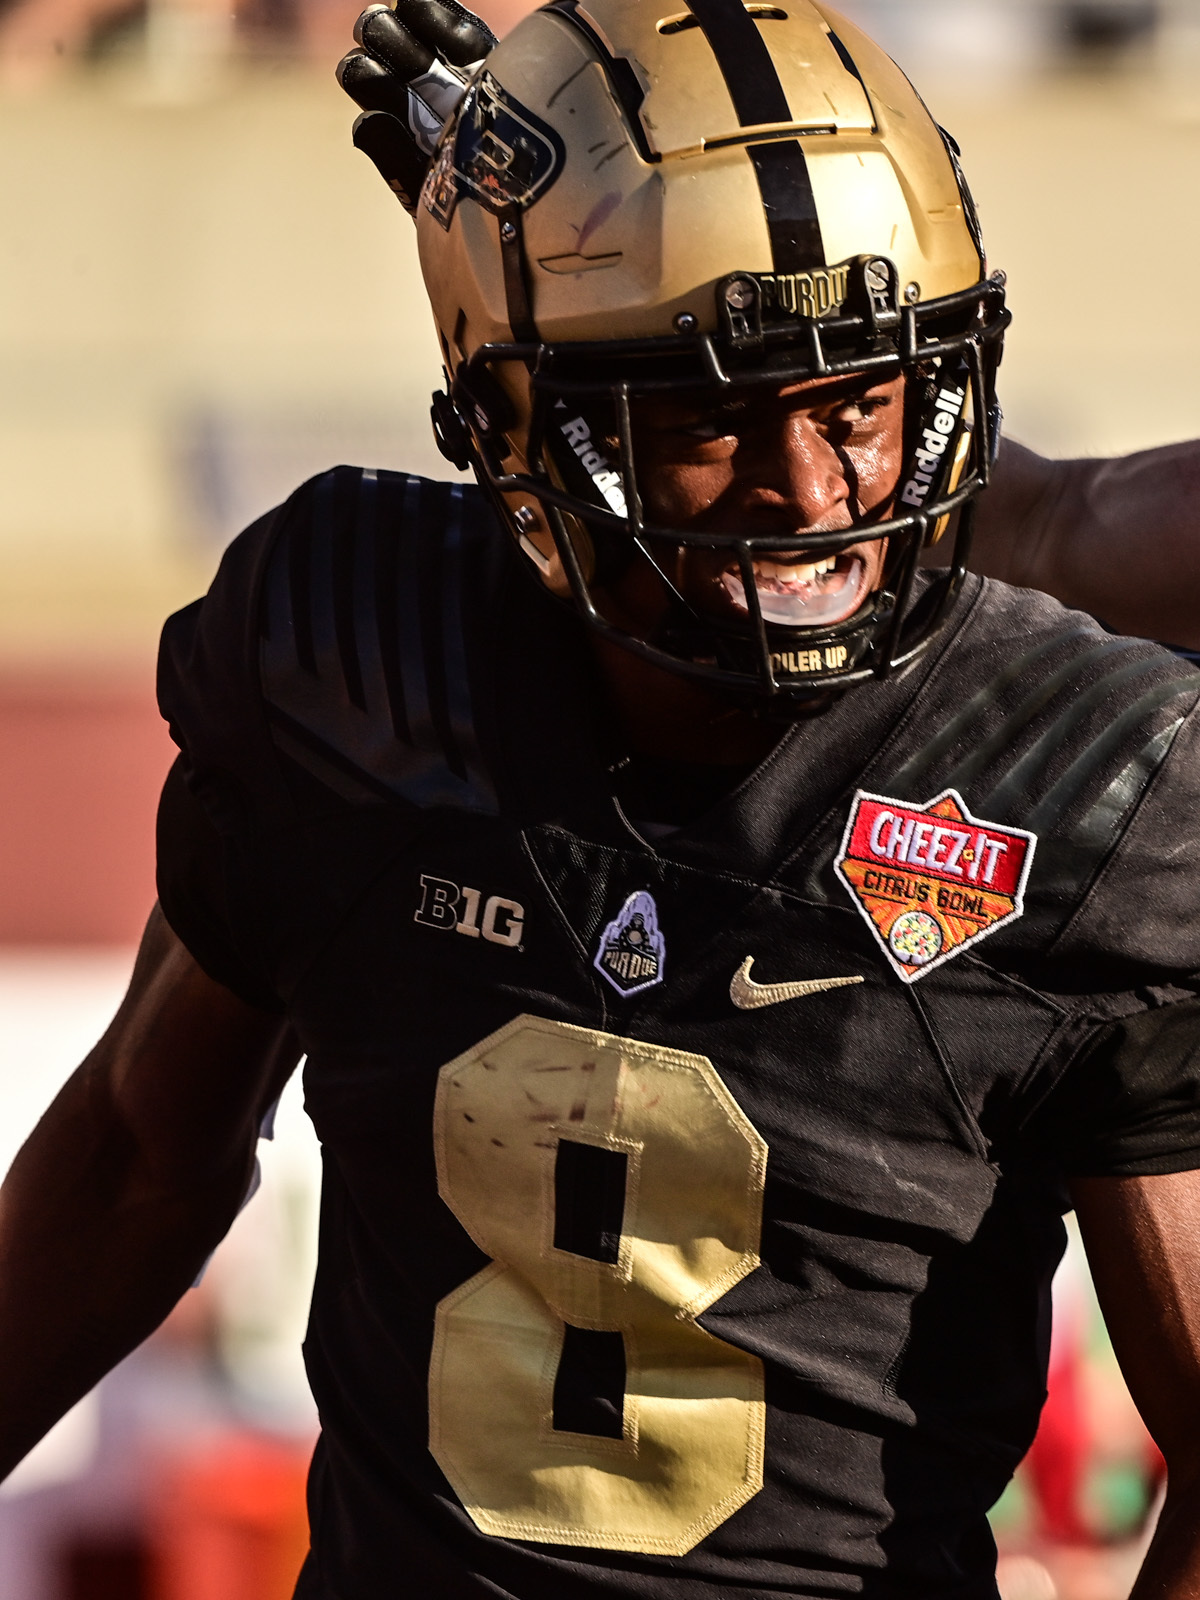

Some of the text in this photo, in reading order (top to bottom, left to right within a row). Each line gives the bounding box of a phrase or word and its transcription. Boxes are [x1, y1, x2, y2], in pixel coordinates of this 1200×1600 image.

[901, 388, 963, 507] Riddell
[769, 645, 848, 674] OILER UP
[864, 869, 988, 917] CITRUS BOWL
[603, 951, 658, 979] PURDUE
[428, 1013, 769, 1556] 8
